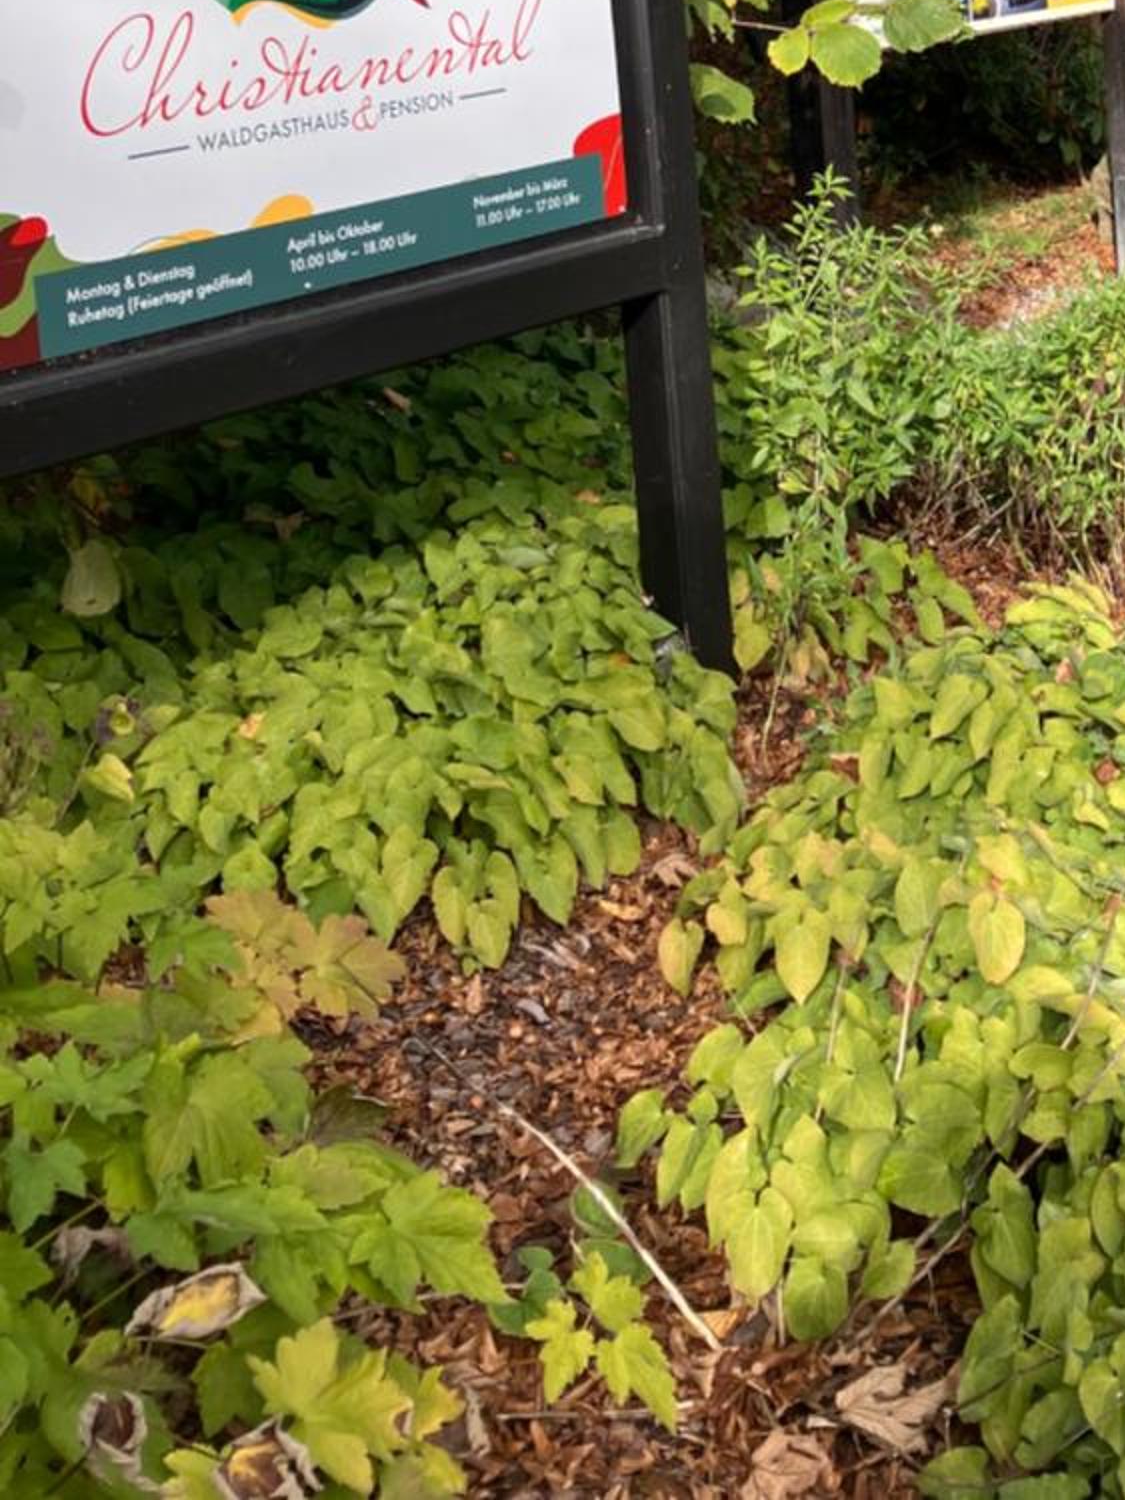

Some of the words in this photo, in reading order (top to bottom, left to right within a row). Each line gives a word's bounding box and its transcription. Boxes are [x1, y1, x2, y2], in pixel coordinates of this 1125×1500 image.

[197, 108, 350, 152] WALDGASTHAUS
[352, 95, 378, 132] &
[380, 92, 455, 120] PENSION
[473, 186, 525, 210] November
[526, 182, 541, 197] bis
[504, 204, 523, 221] Uhr
[288, 232, 316, 253] April
[318, 228, 336, 245] bis
[337, 220, 384, 241] Oktober
[290, 253, 325, 273] 10.00
[326, 247, 348, 263] Uhr
[363, 235, 395, 255] 18.00
[397, 230, 417, 247] Uhr
[66, 280, 122, 304] Montag
[124, 273, 135, 290] &
[138, 264, 196, 288] Dienstag
[67, 302, 125, 328] Ruhetag
[128, 286, 194, 317] (Feiertage
[196, 268, 254, 301] geöffnet)
